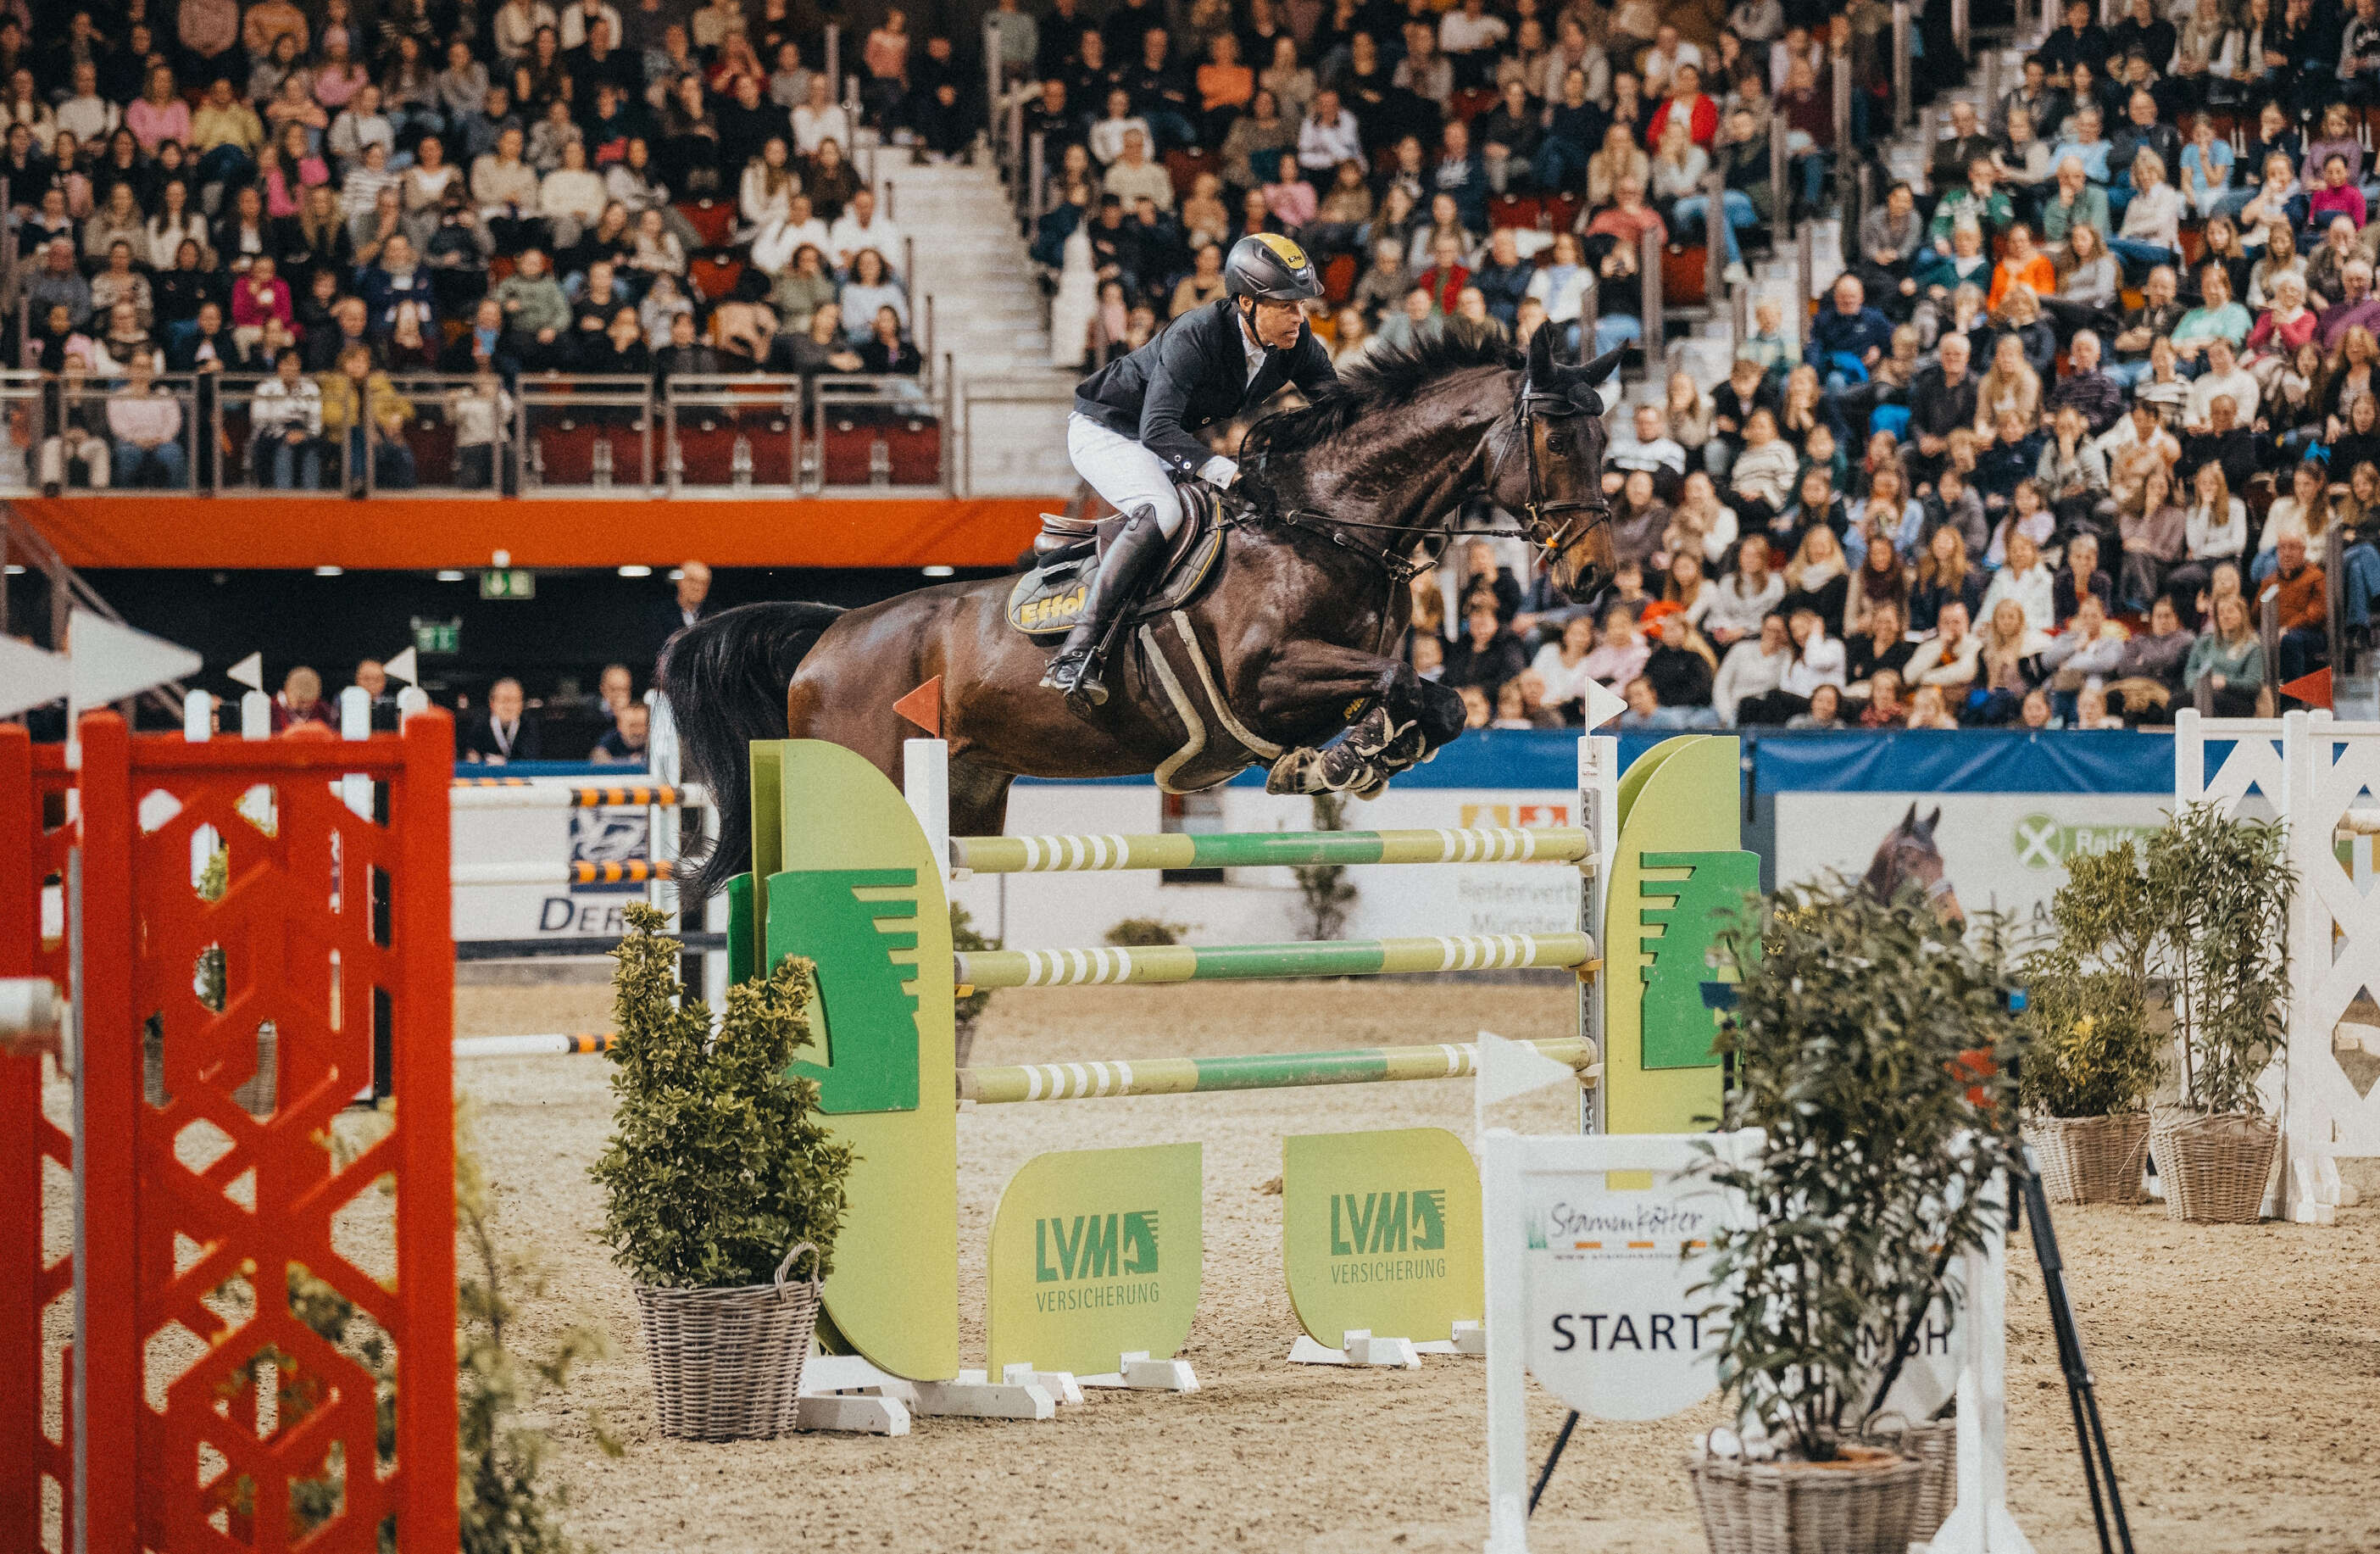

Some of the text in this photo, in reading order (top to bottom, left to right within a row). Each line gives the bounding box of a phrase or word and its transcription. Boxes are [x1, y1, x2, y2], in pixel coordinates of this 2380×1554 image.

[540, 898, 625, 932] DER
[1332, 1191, 1408, 1256] LVM
[1036, 1213, 1119, 1283] LVM
[1331, 1258, 1445, 1284] VERSICHERUNG
[1036, 1281, 1159, 1313] VERSICHERUNG
[1552, 1313, 1703, 1351] START
